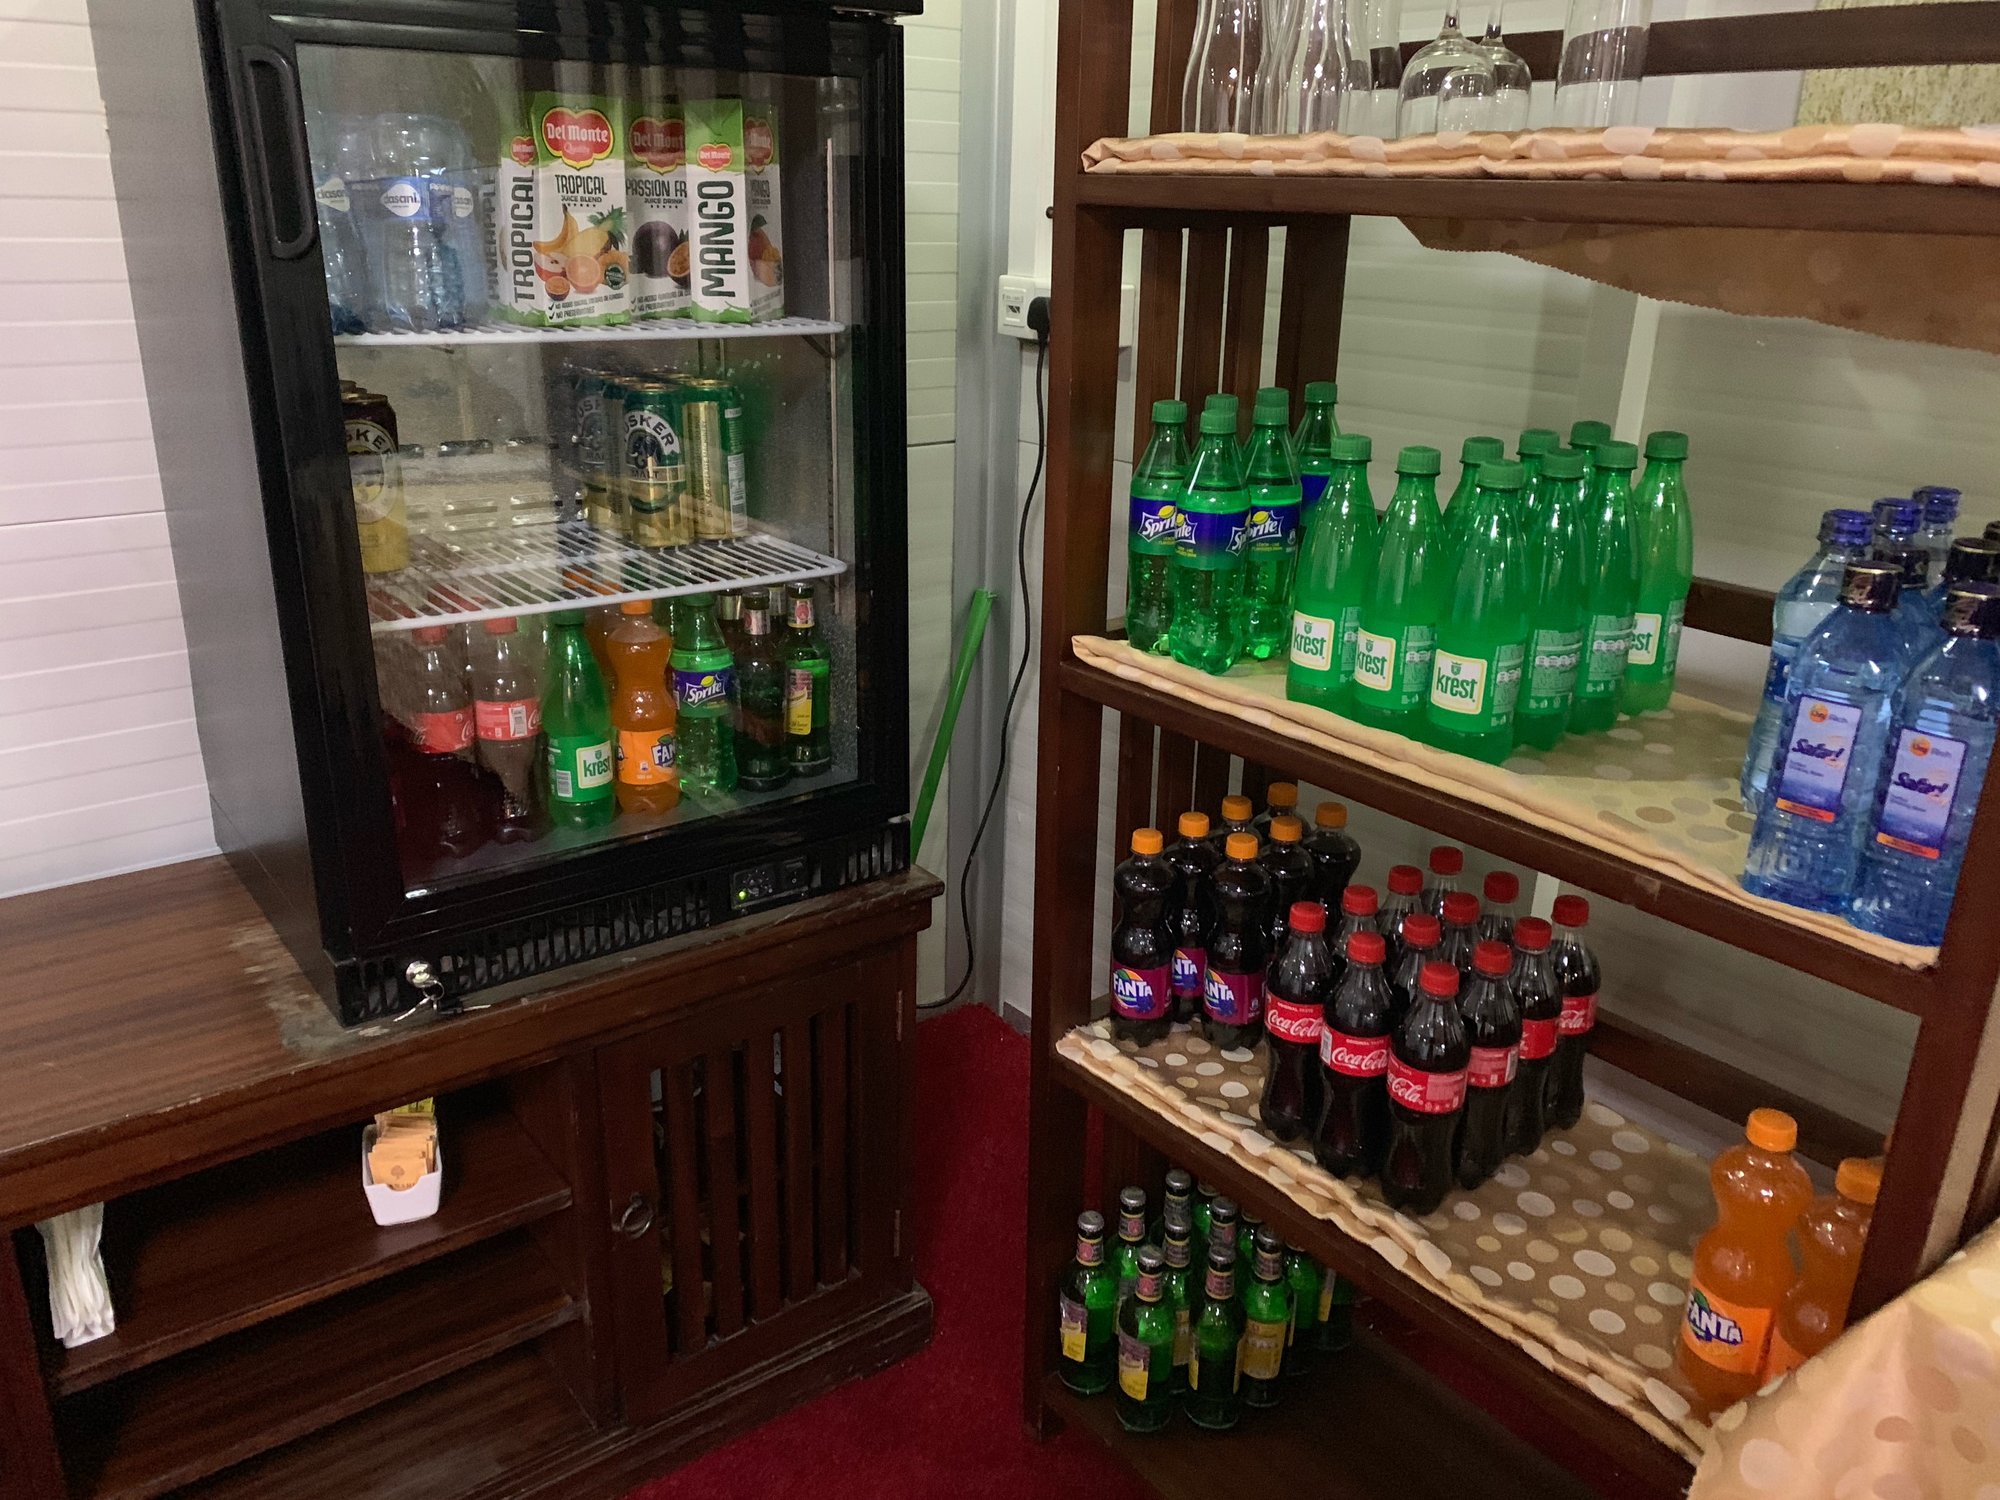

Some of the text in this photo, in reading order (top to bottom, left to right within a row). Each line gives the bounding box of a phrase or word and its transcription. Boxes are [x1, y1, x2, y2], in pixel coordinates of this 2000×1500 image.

[546, 122, 608, 142] Del Monte
[632, 131, 684, 148] Del Mont
[555, 174, 608, 196] TROPICAL
[625, 178, 671, 198] PASSION
[580, 195, 602, 203] BLEND
[510, 168, 535, 304] TROPICAL
[696, 180, 737, 298] MANGO
[1293, 632, 1327, 658] krest
[1630, 632, 1653, 651] est
[1357, 649, 1388, 677] krest
[687, 680, 722, 703] Sprite
[1436, 666, 1478, 700] krest
[1113, 974, 1153, 997] FANTA
[1205, 979, 1234, 1001] ANTA
